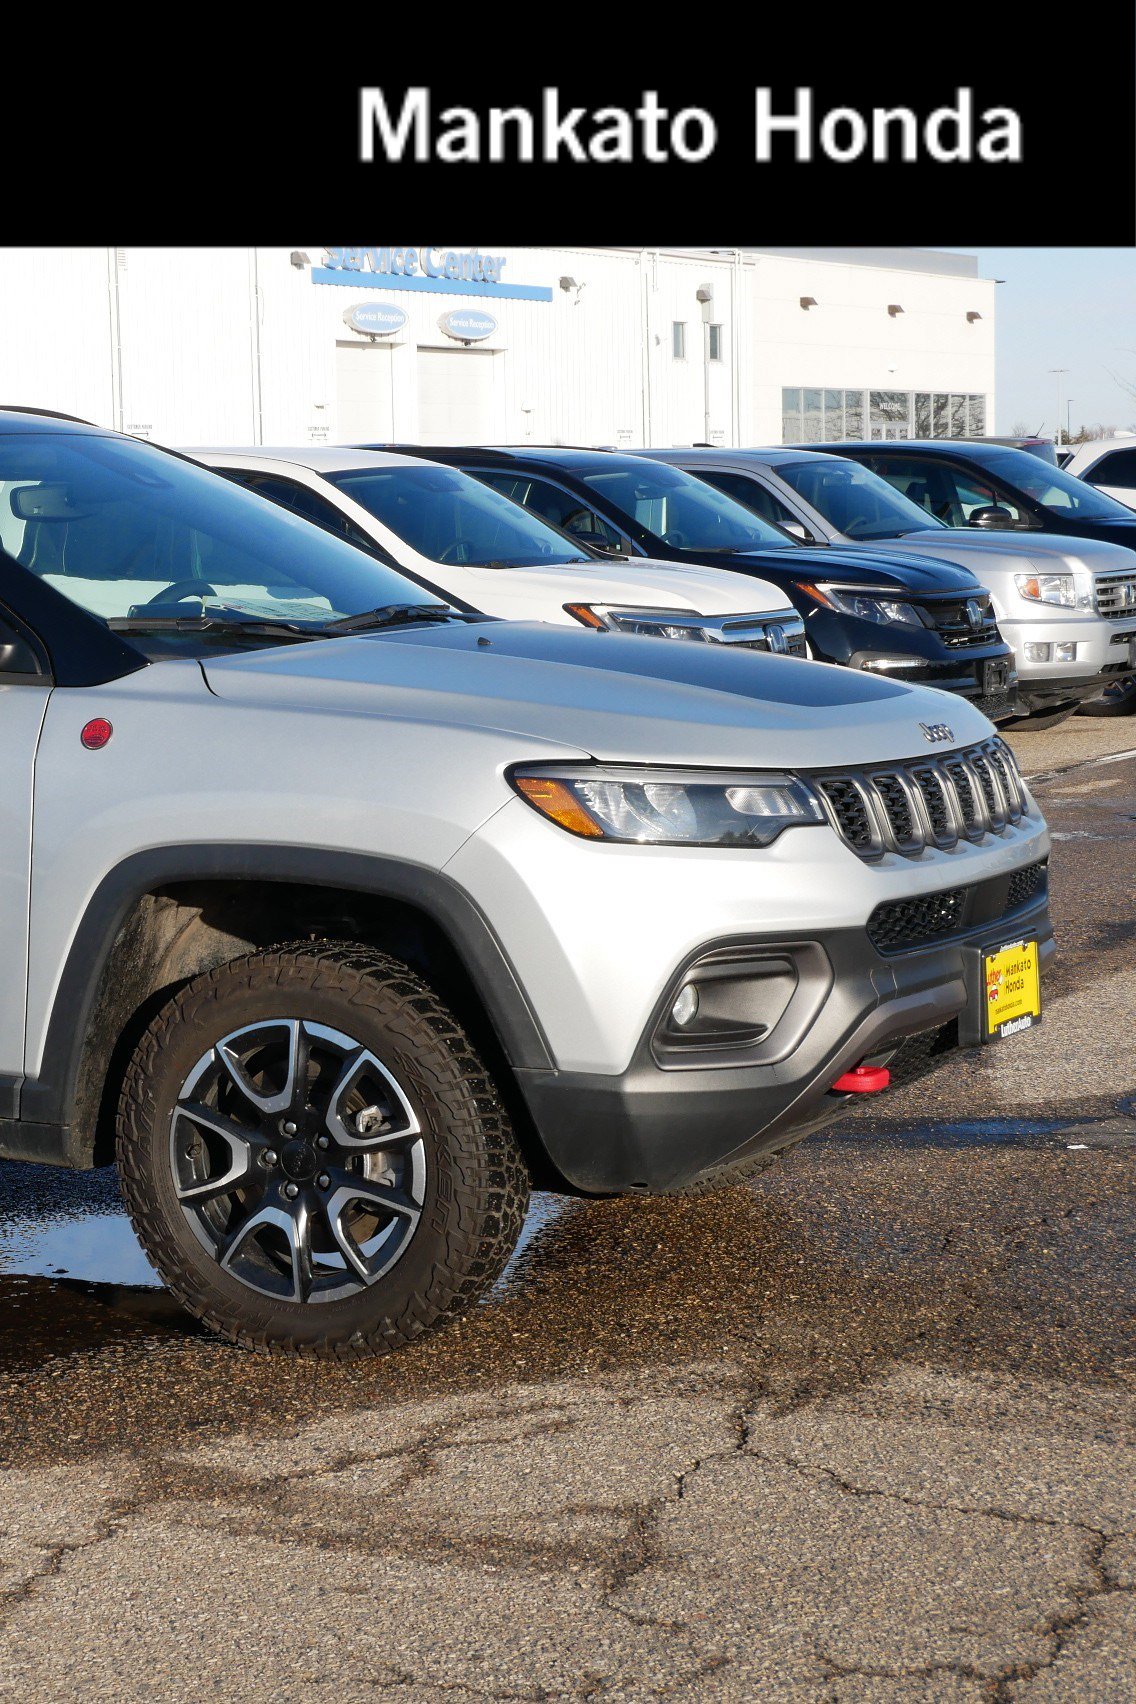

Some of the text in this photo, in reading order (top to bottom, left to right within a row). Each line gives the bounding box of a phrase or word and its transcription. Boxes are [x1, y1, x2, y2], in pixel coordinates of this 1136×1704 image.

[321, 246, 507, 284] Service Center
[355, 310, 405, 324] Service Reception
[449, 316, 495, 331] Service Reception
[919, 722, 955, 743] Jeep
[986, 967, 1002, 986] uther
[1005, 958, 1032, 977] Mankato
[1005, 976, 1024, 994] Honda
